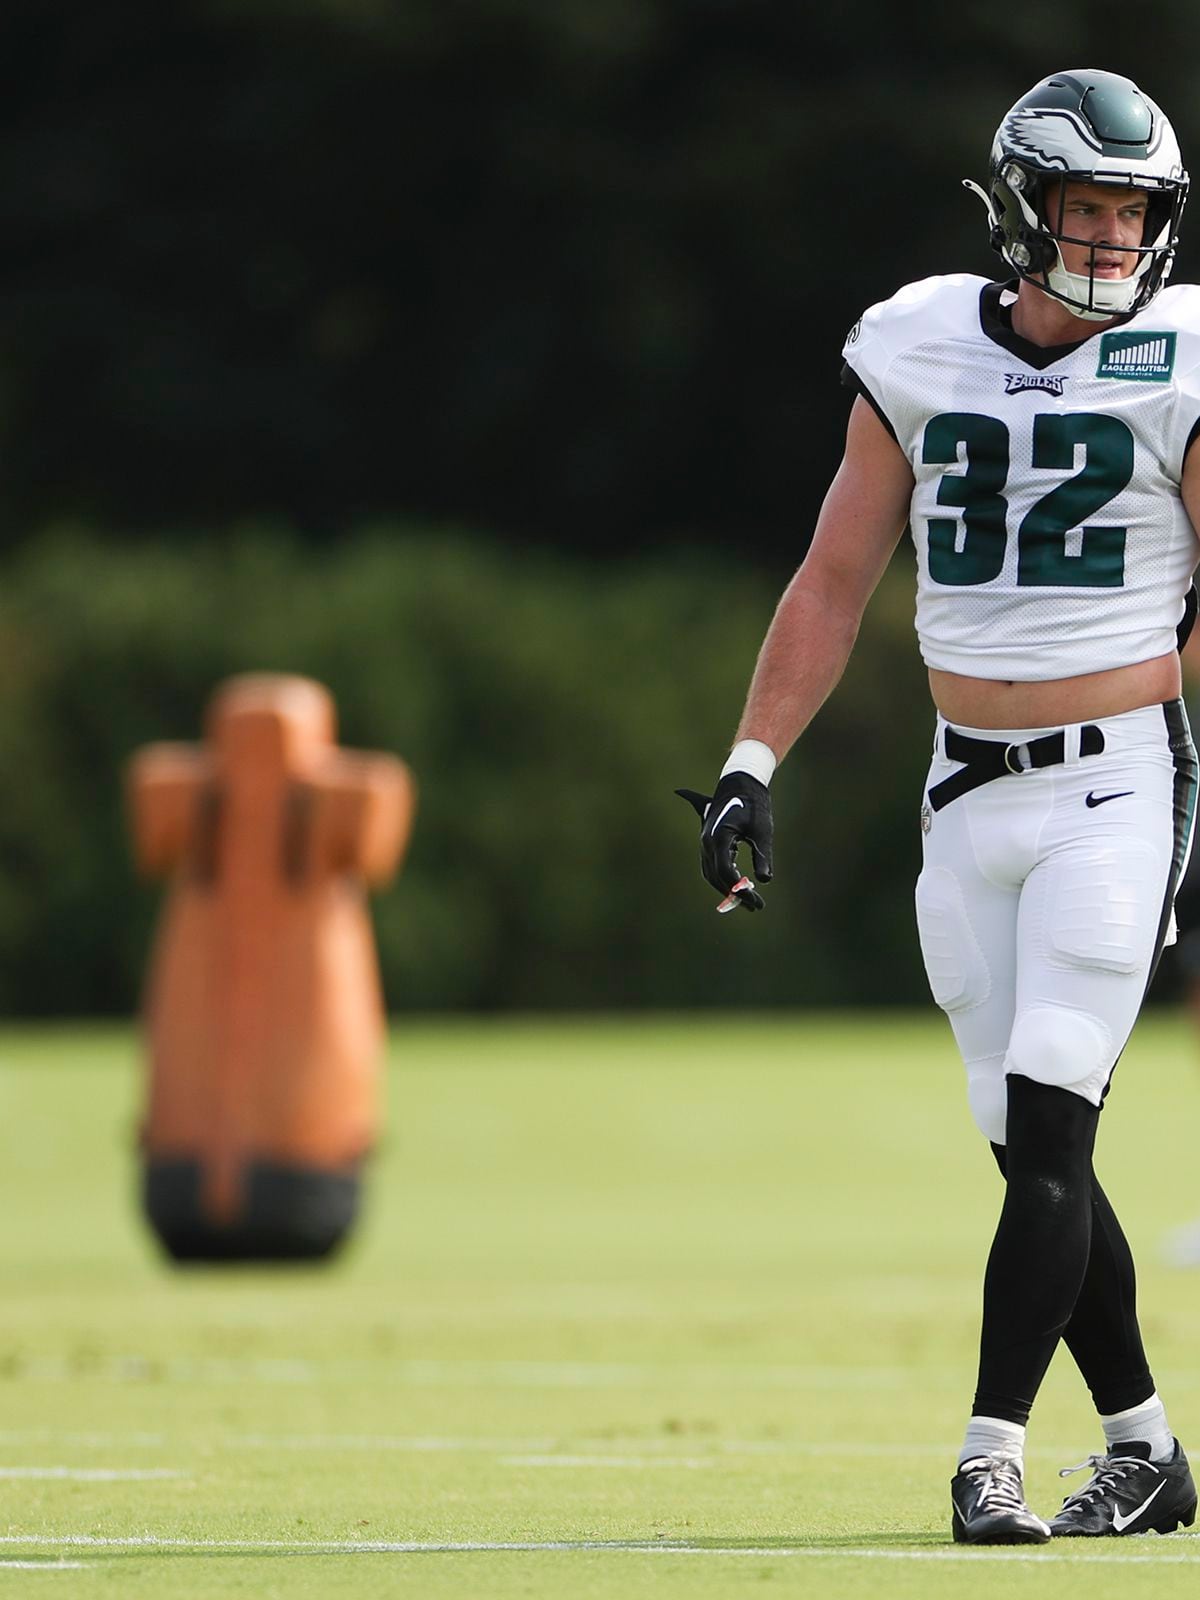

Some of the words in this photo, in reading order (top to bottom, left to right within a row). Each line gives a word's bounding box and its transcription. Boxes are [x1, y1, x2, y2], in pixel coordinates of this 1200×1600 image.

[1102, 364, 1135, 372] EAGLES
[1135, 365, 1170, 373] AUTISM
[1004, 374, 1069, 397] EAGLES
[922, 412, 1134, 588] 32
